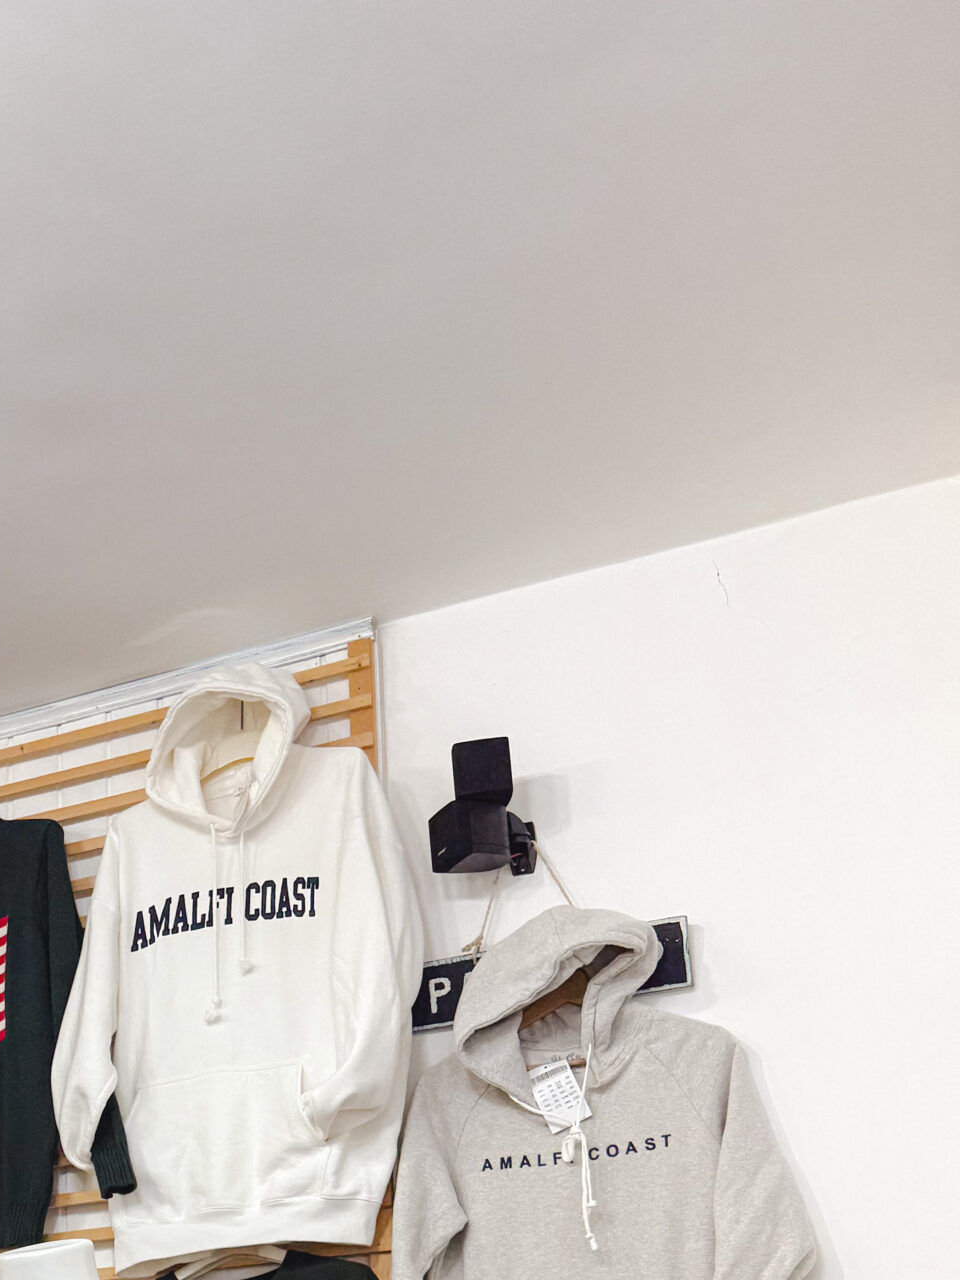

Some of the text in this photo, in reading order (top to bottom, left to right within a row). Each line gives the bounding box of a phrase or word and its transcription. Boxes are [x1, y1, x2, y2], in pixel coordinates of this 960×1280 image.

[130, 876, 320, 953] AMALFI COAST
[481, 1133, 672, 1172] AMALF COAST
